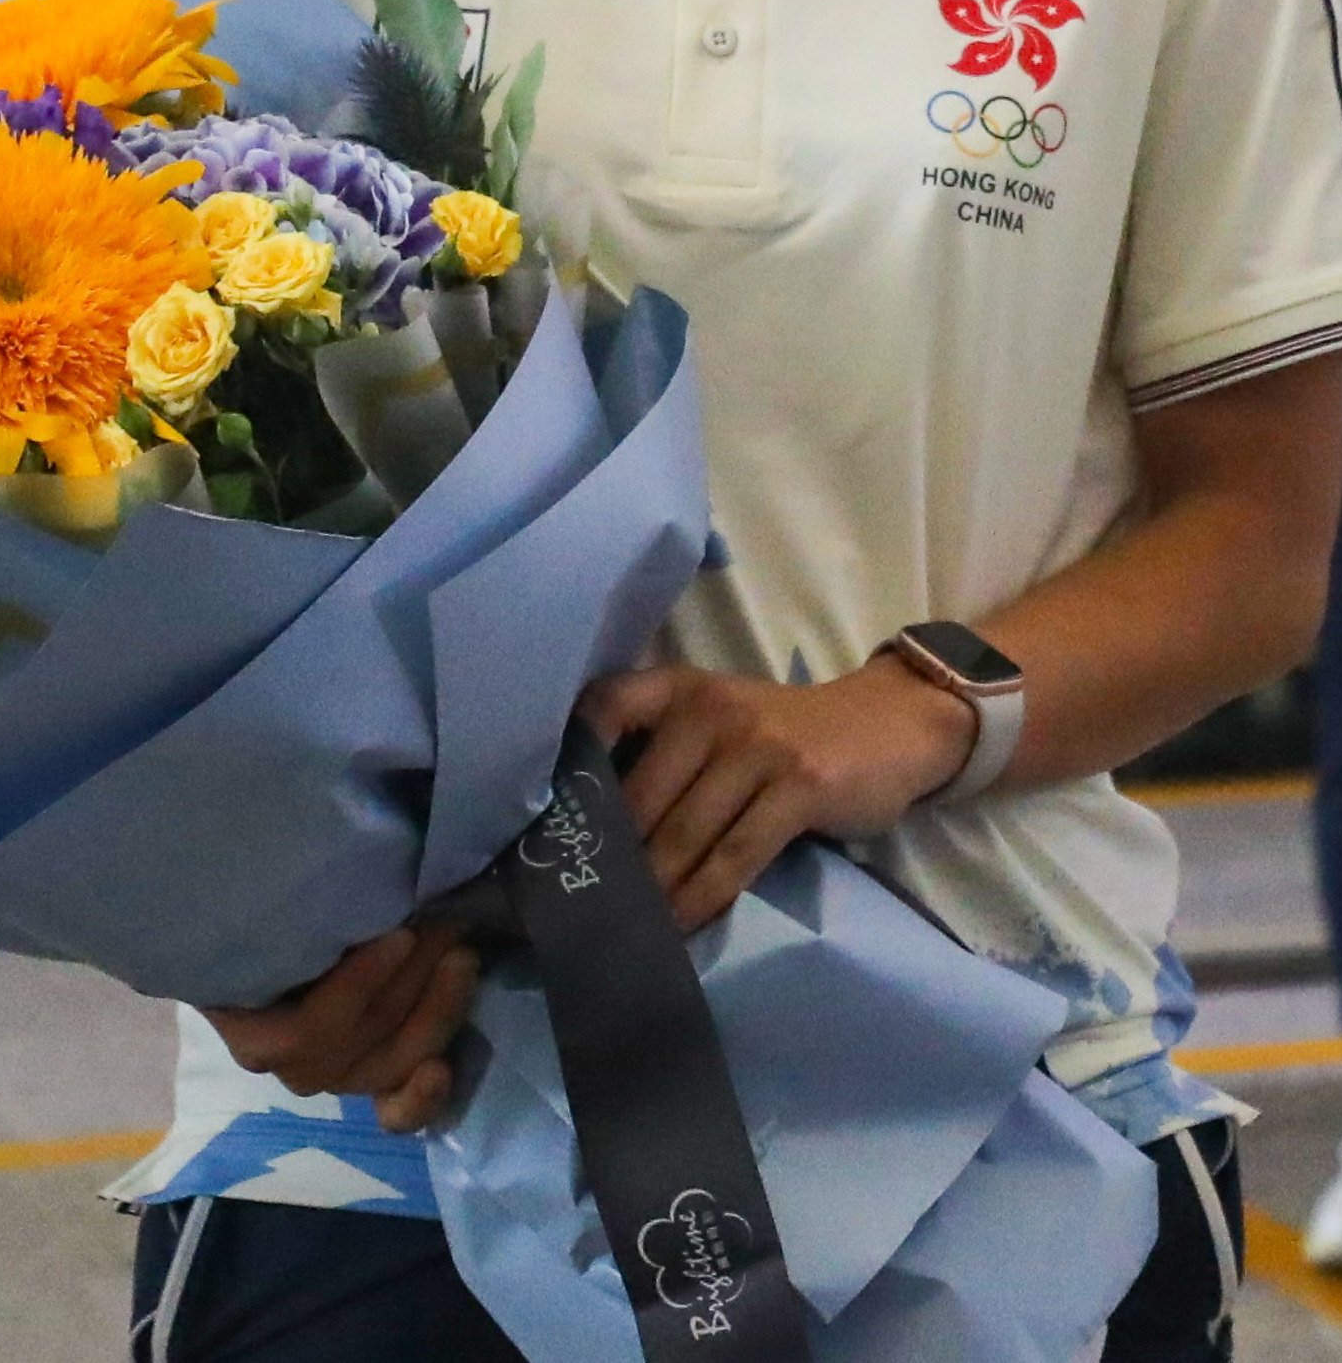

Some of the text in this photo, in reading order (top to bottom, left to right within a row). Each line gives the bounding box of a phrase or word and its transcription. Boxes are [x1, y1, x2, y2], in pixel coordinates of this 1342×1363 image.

[922, 167, 1056, 210] HONG KONG
[957, 201, 1025, 235] CHINA
